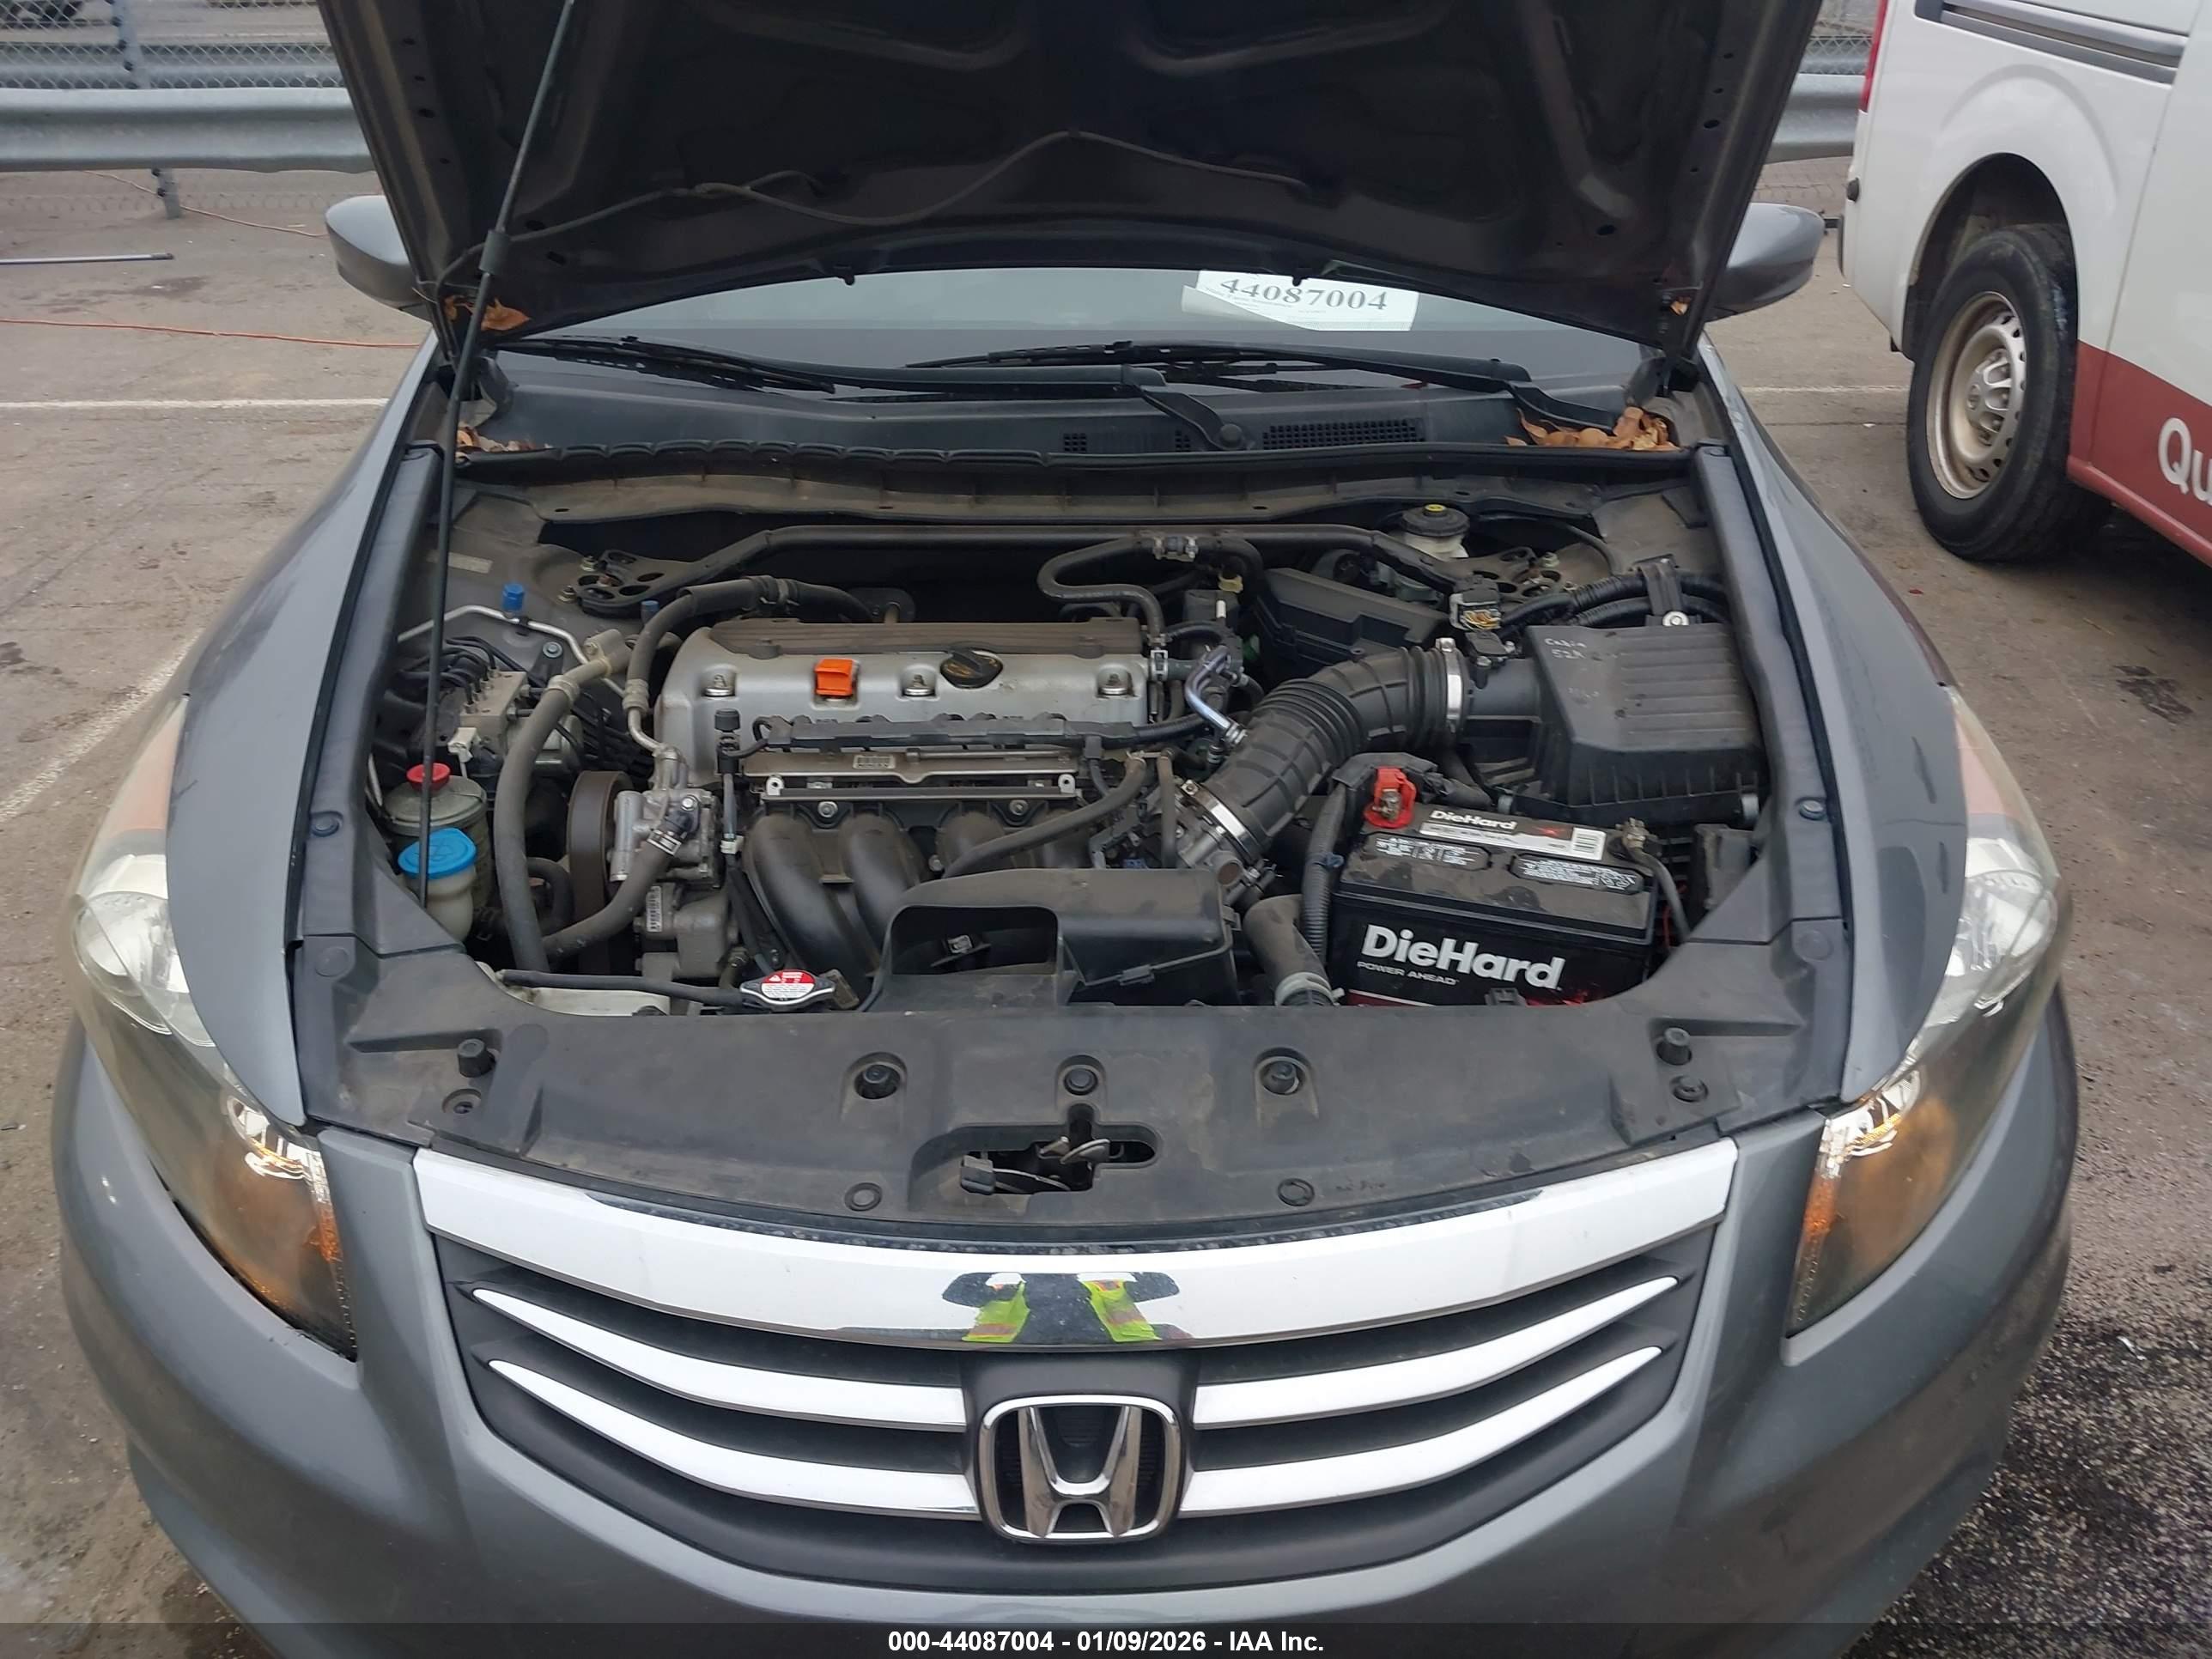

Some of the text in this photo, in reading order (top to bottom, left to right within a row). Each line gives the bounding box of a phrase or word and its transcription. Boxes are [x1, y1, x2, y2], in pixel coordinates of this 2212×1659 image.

[1220, 279, 1388, 310] 44087004
[1430, 810, 1518, 830] DieHard
[1357, 961, 1405, 975] POWER
[1361, 924, 1566, 990] DieHard
